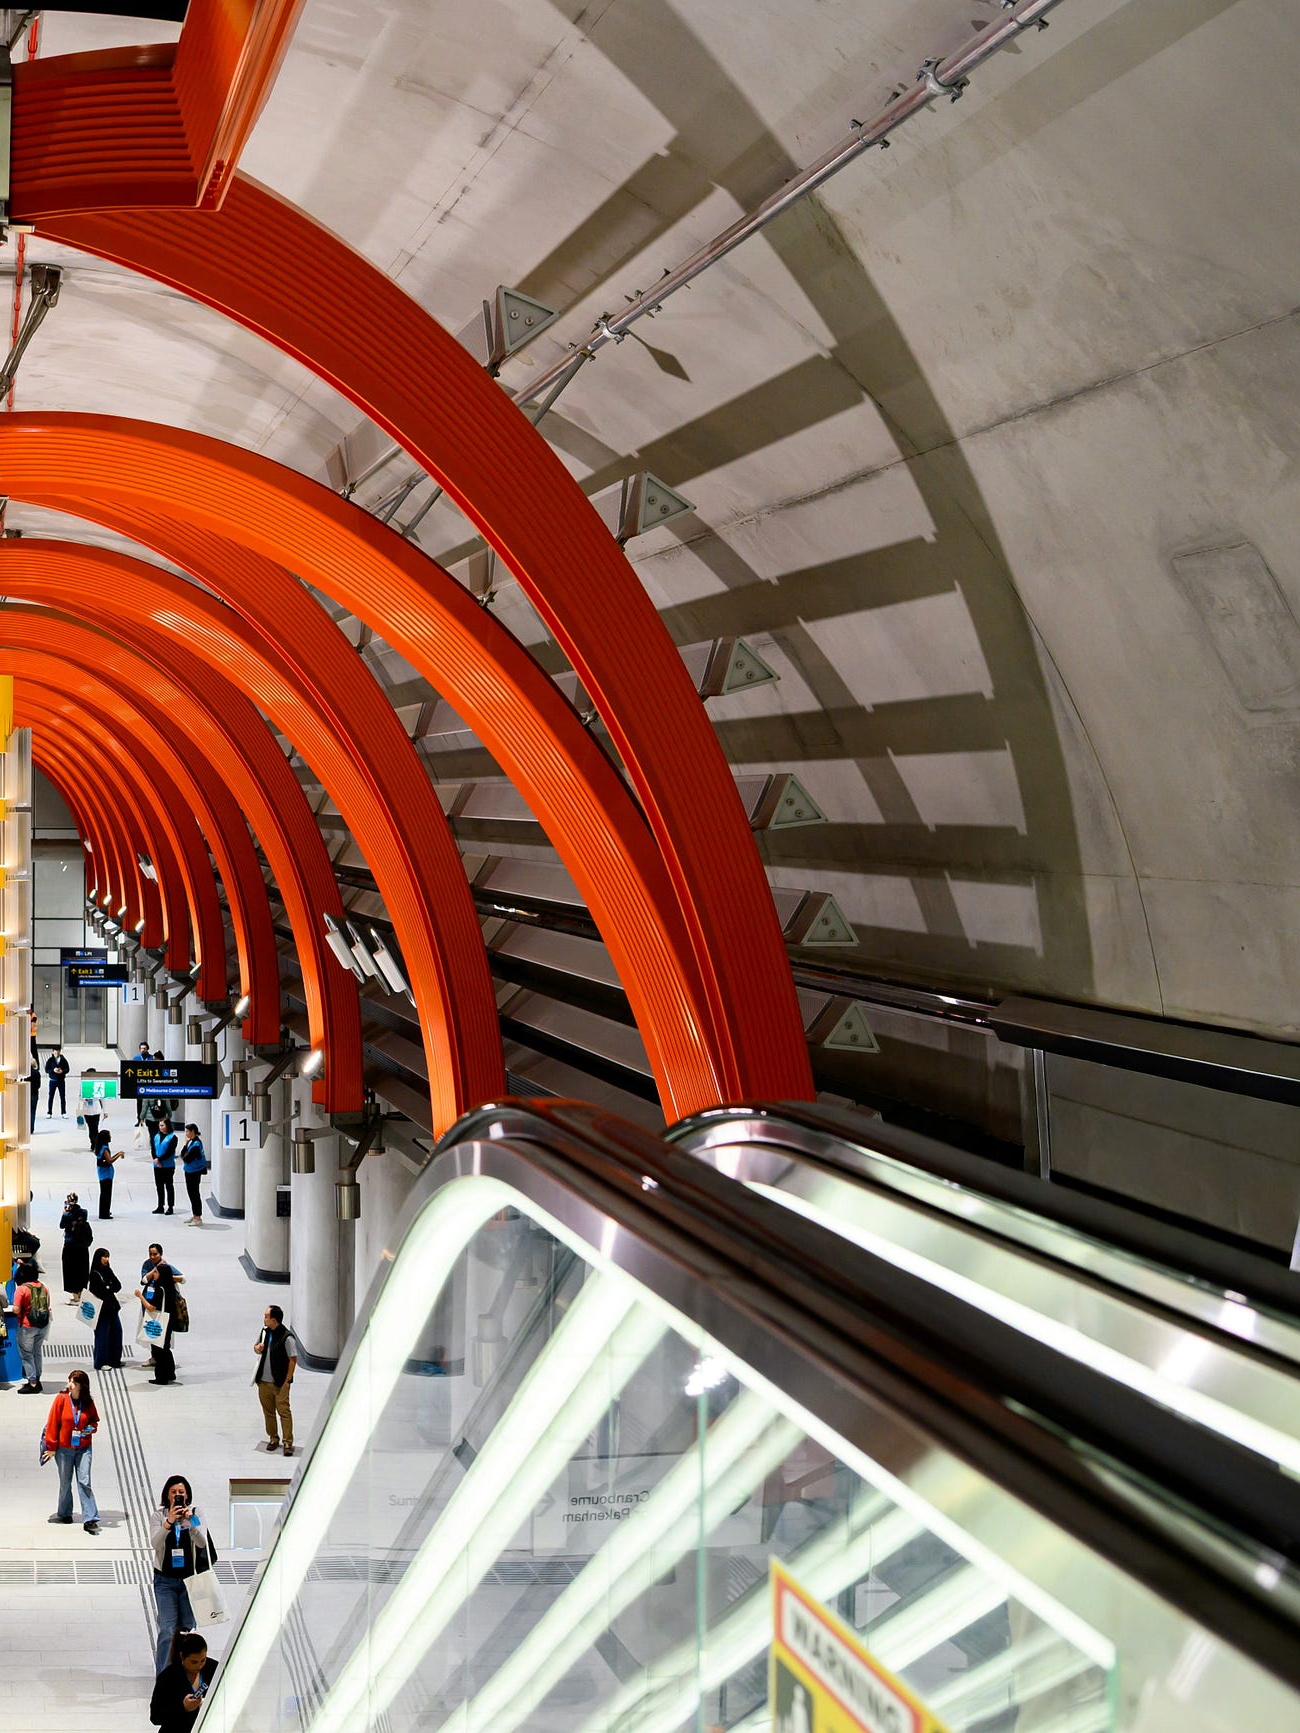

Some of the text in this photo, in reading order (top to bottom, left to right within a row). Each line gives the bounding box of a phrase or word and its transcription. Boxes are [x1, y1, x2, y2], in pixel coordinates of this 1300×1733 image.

[131, 987, 139, 1001] 1
[137, 1069, 160, 1077] Exit 1
[238, 1118, 251, 1142] 1
